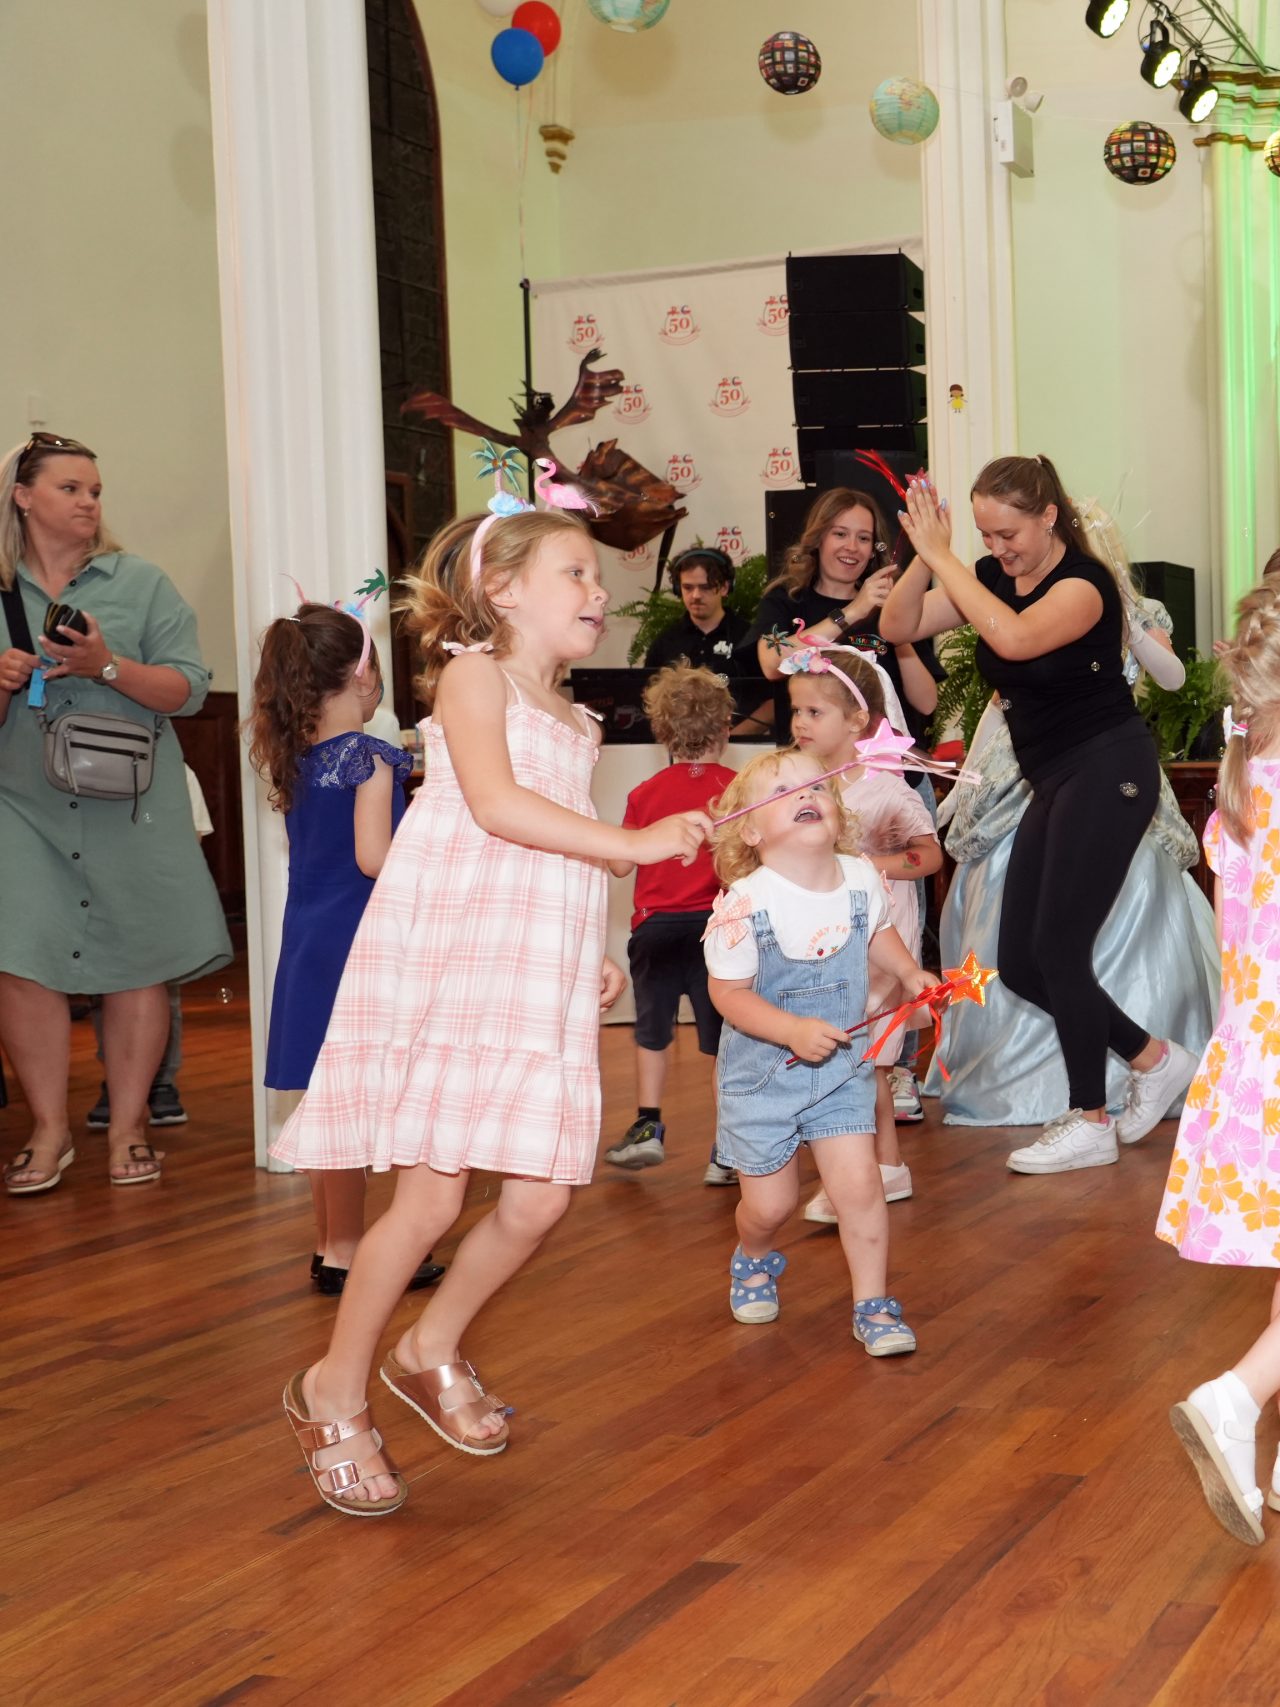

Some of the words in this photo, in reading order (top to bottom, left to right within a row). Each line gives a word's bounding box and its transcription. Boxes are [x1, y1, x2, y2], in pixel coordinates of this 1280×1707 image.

[768, 307, 787, 324] 50
[669, 318, 690, 333] 50
[576, 327, 594, 342] 50
[623, 396, 642, 412] 50
[720, 389, 740, 405] 50
[670, 466, 691, 481] 50
[770, 460, 790, 475] 50
